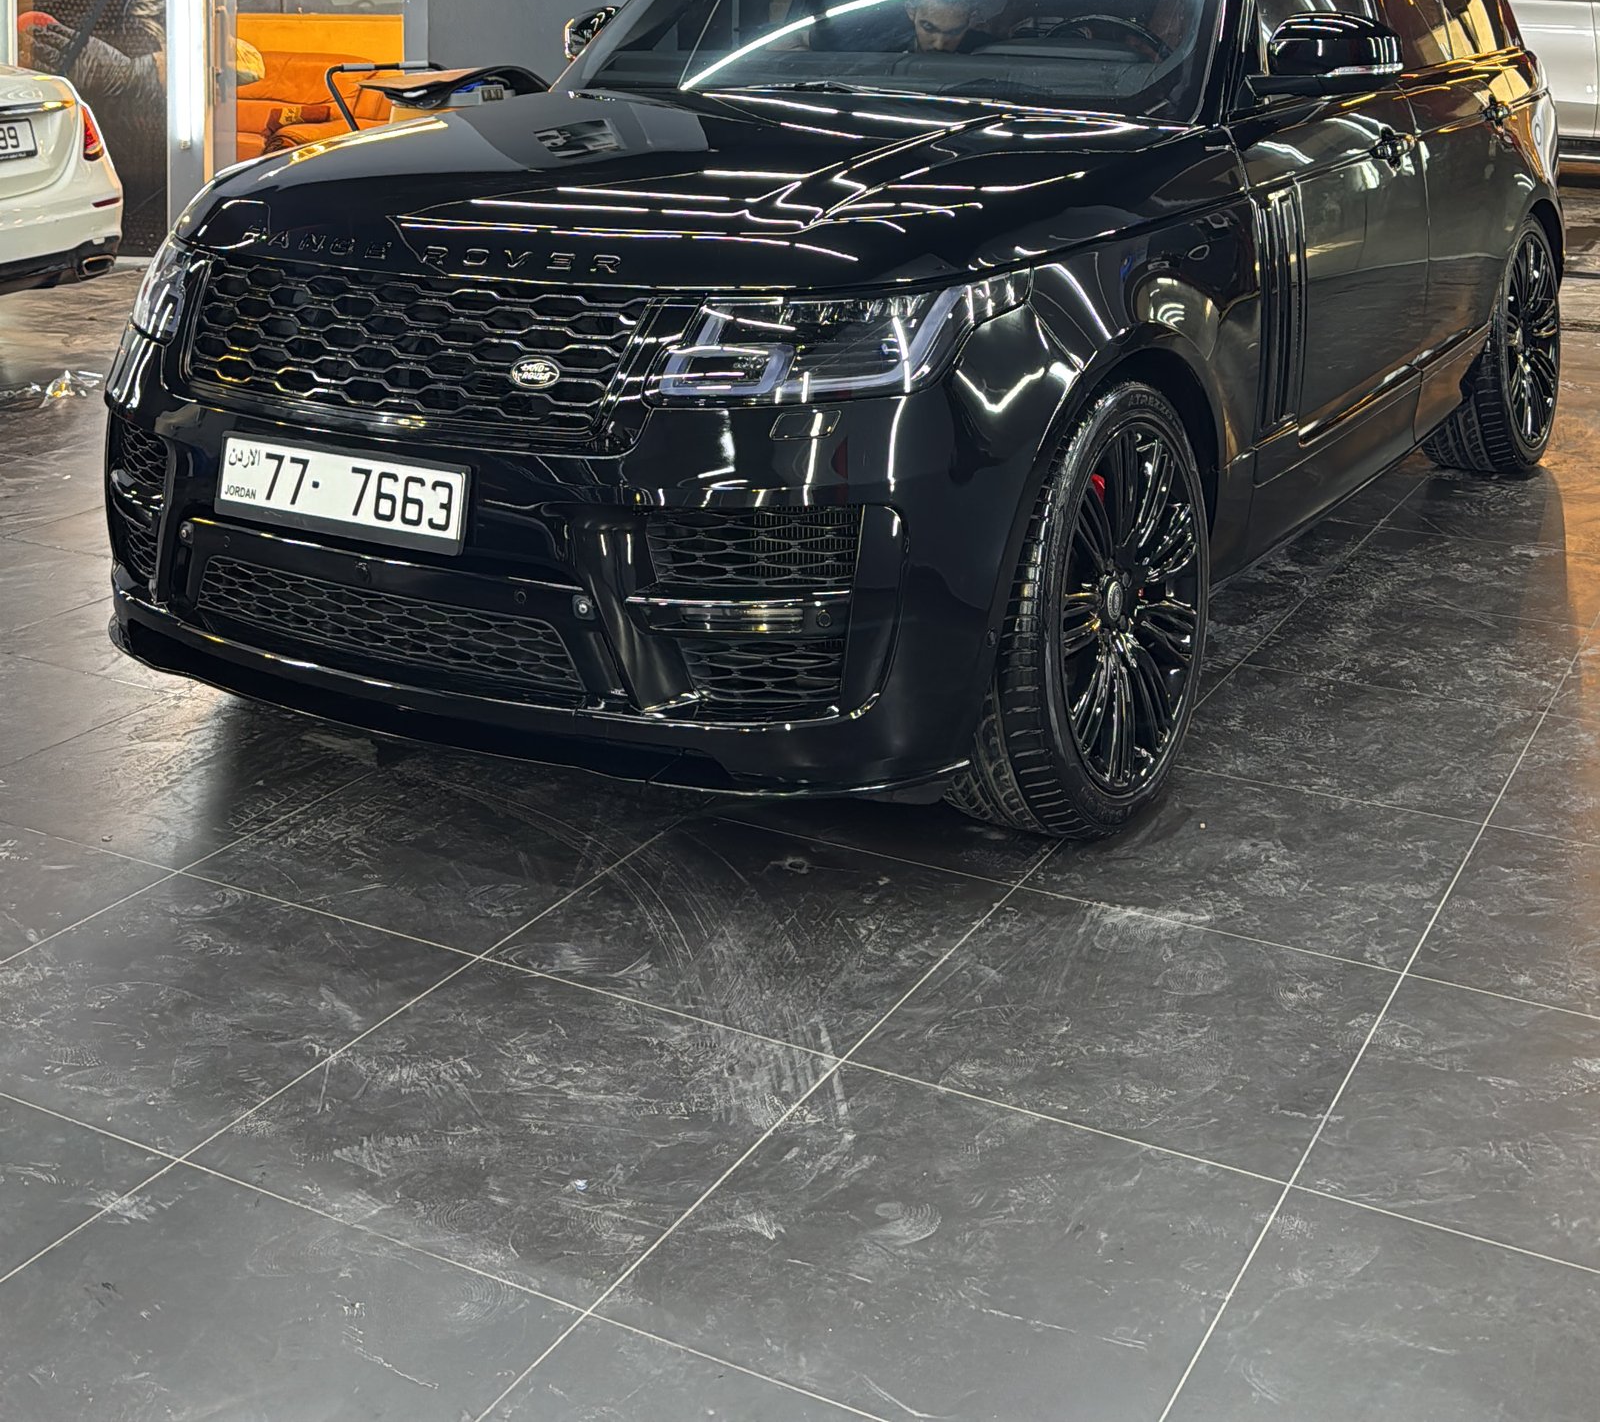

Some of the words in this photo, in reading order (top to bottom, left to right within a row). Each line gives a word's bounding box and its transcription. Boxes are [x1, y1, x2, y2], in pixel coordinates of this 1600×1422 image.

[422, 245, 622, 274] ROVER
[224, 484, 257, 500] JORDAN
[351, 466, 454, 532] 7663
